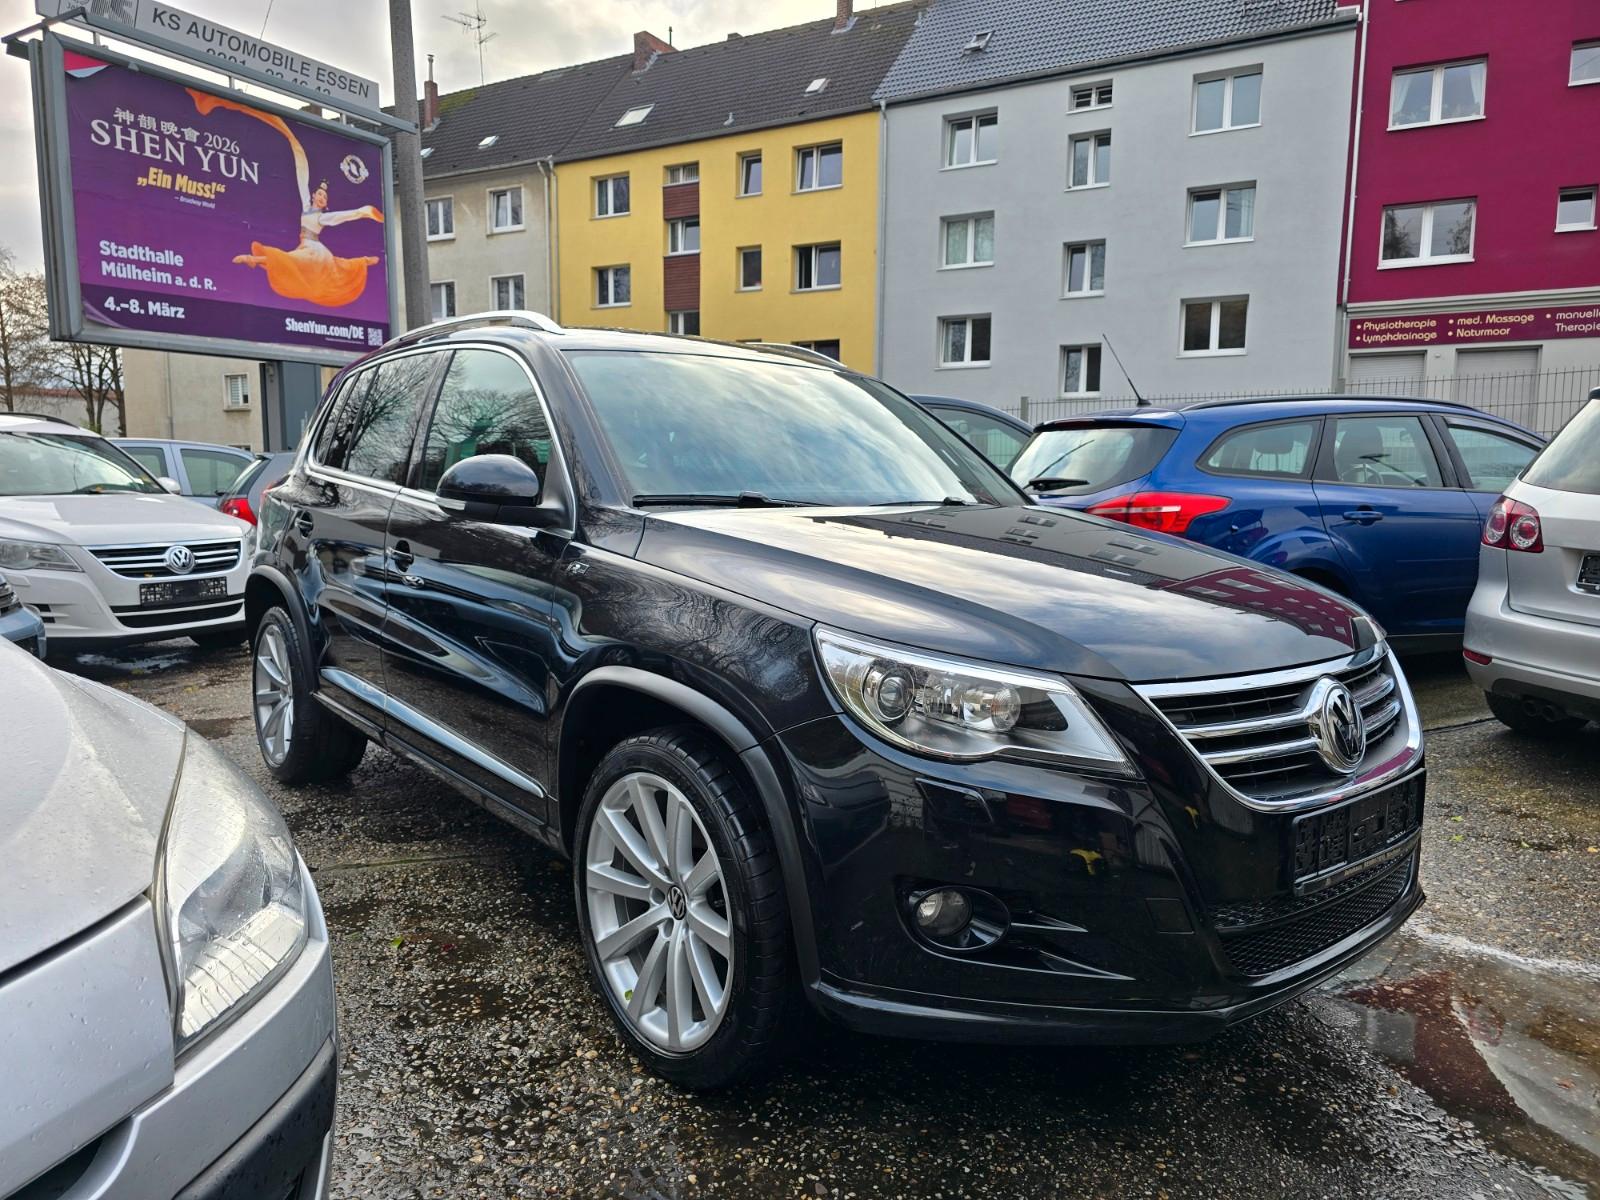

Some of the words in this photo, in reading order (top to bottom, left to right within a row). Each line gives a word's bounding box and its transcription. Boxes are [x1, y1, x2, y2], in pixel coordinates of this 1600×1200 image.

[152, 7, 181, 31] KS
[186, 21, 311, 77] AUTOMOBILE
[316, 67, 369, 98] ESSEN
[90, 119, 186, 166] SHEN
[194, 145, 259, 185] YUN
[203, 132, 240, 155] 2026
[99, 240, 184, 267] Stadthalle
[101, 260, 172, 285] Mülheim
[174, 275, 187, 287] a.
[189, 275, 202, 289] d.
[204, 278, 217, 291] R.
[147, 301, 185, 319] März
[1457, 315, 1482, 325] med.
[1485, 313, 1535, 325] Massage
[1556, 308, 1600, 320] manuell
[285, 317, 365, 340] ShenYun.com/DE
[1363, 319, 1437, 332] Physiotherapie
[1456, 327, 1511, 338] Naturmoor
[1362, 332, 1437, 344] Lymphdrainage
